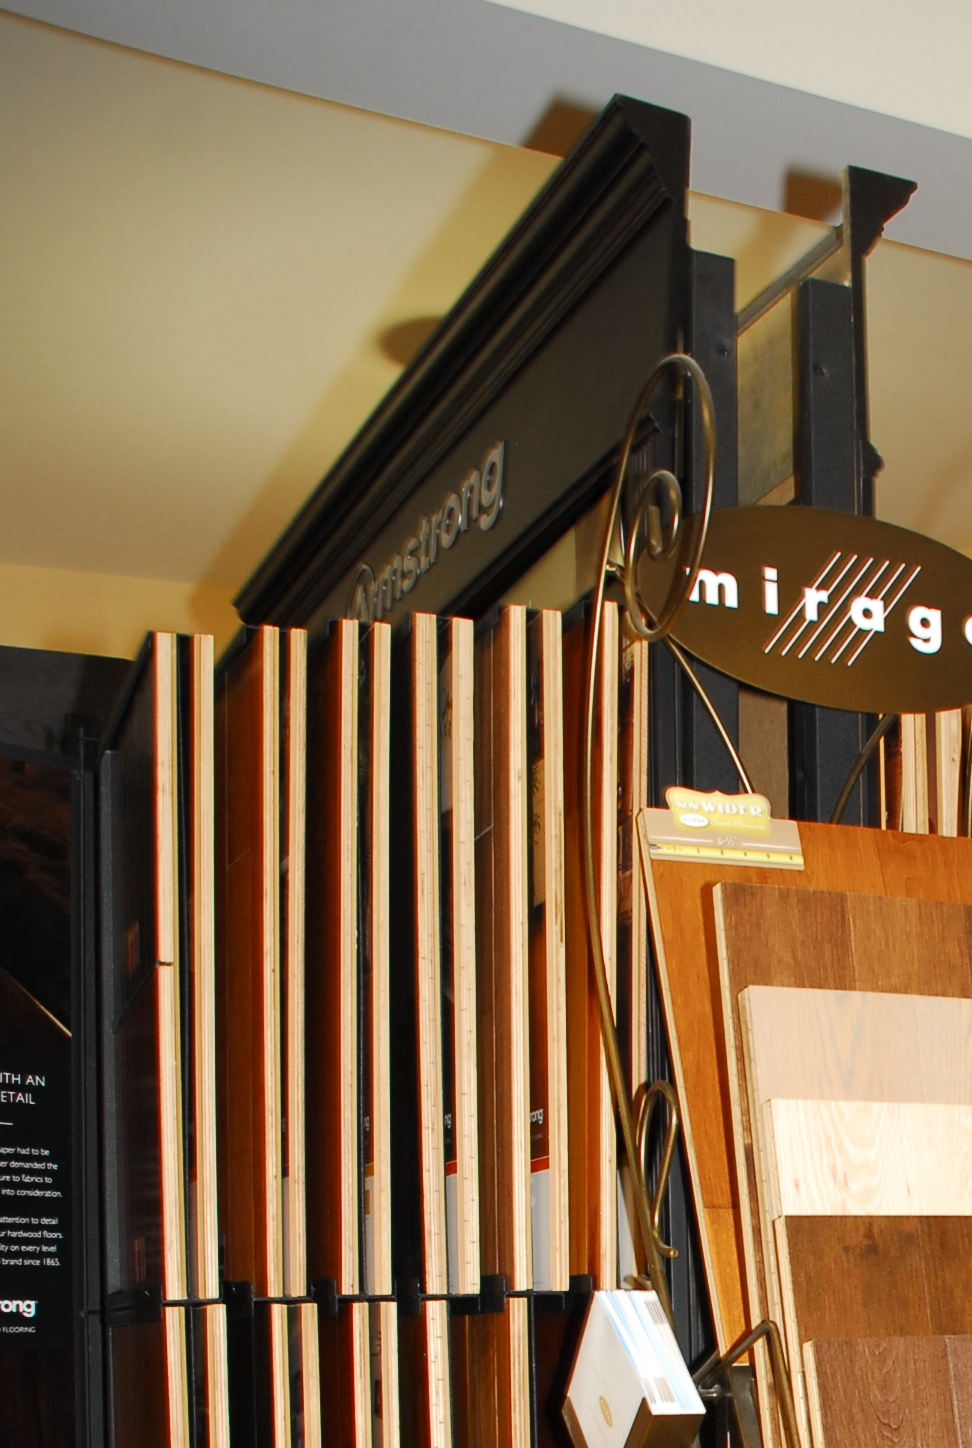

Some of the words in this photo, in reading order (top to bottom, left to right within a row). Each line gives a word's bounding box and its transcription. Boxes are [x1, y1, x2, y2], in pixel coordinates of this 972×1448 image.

[346, 440, 505, 625] Armstrong
[700, 801, 763, 818] WIDER
[25, 1074, 46, 1087] AN
[16, 1147, 30, 1155] had
[40, 1148, 51, 1156] be
[9, 1160, 46, 1169] demanded
[47, 1162, 59, 1170] the
[12, 1173, 21, 1182] to
[21, 1174, 44, 1183] fabrics
[44, 1175, 53, 1184] to
[1, 1187, 16, 1196] into
[16, 1189, 63, 1198] consideration.
[40, 1217, 59, 1225] detail
[7, 1229, 42, 1238] hardwood
[42, 1230, 64, 1239] floors.
[20, 1245, 41, 1254] every
[41, 1245, 58, 1253] level
[1, 1257, 23, 1266] brand
[23, 1258, 41, 1267] since
[0, 1299, 36, 1318] ong
[2, 1326, 36, 1334] FLOORING
